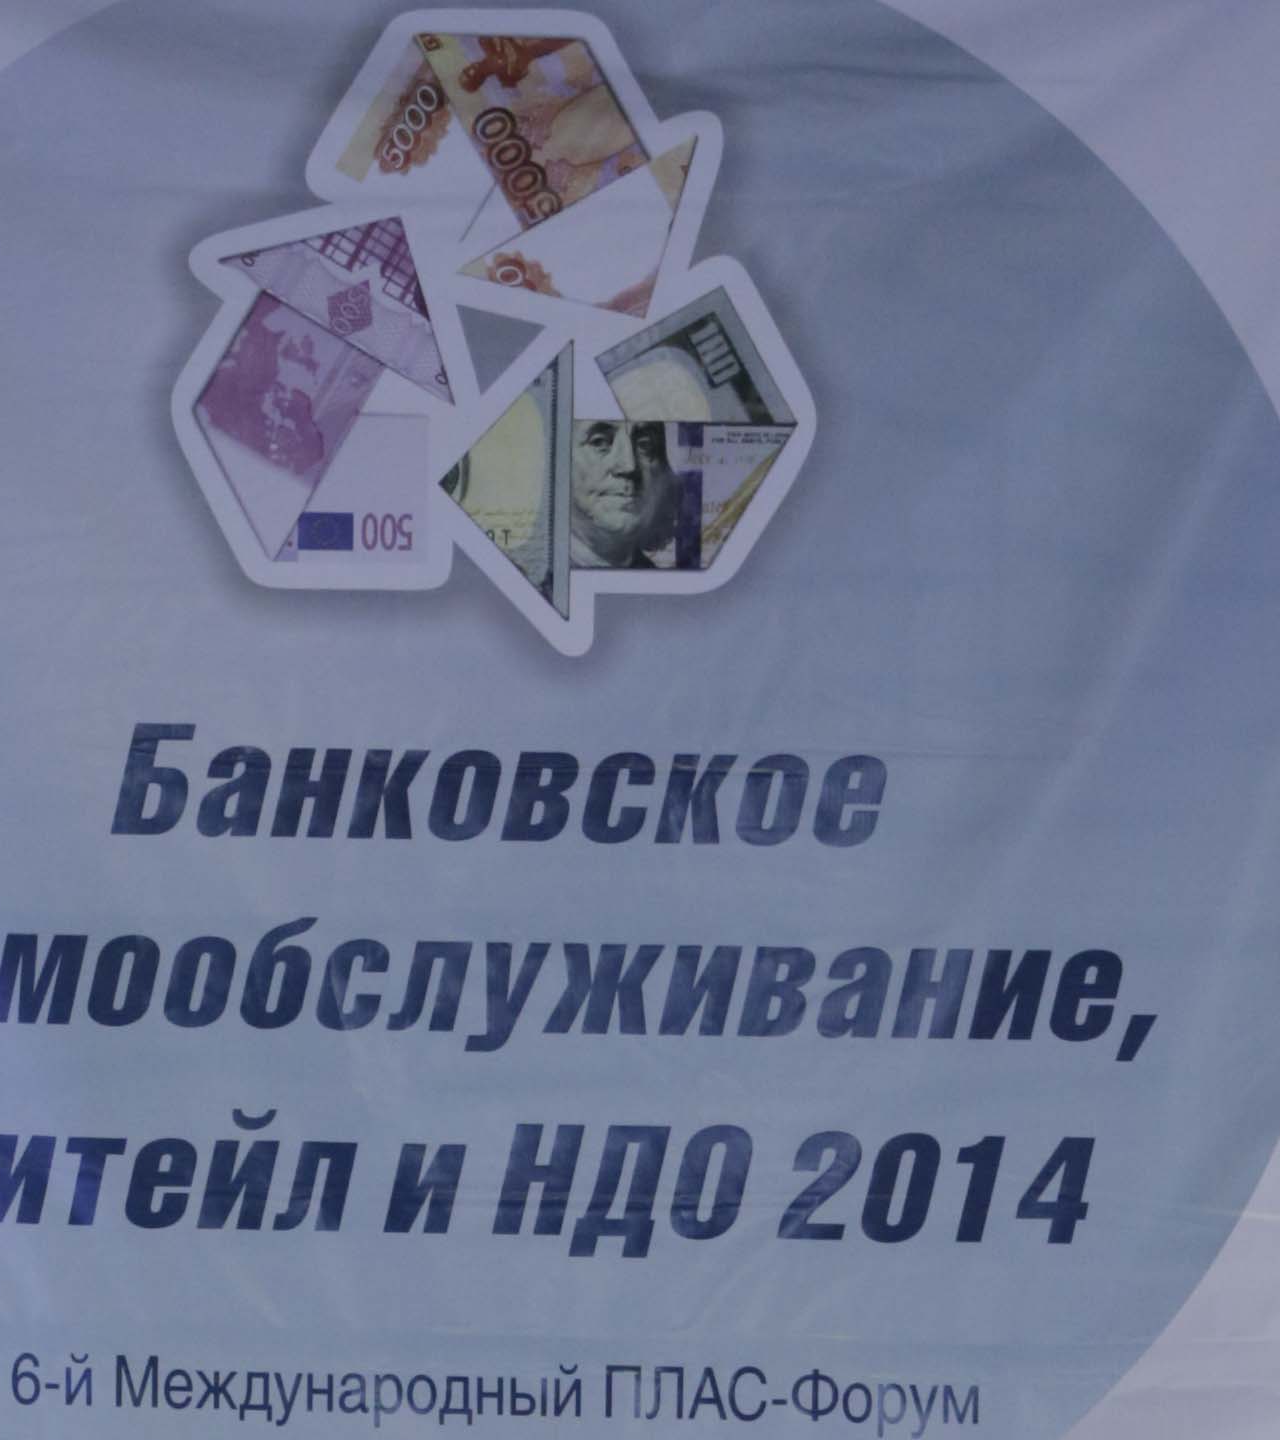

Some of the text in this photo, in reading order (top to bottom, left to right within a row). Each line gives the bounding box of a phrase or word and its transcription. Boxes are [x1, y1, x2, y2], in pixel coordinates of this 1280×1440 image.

[111, 721, 888, 848] Банковское
[382, 1138, 468, 1236] и
[490, 1122, 754, 1259] НДО
[776, 1130, 1098, 1246] 2014
[11, 1352, 981, 1438] 6-й Международный ПЛАС-Форум
